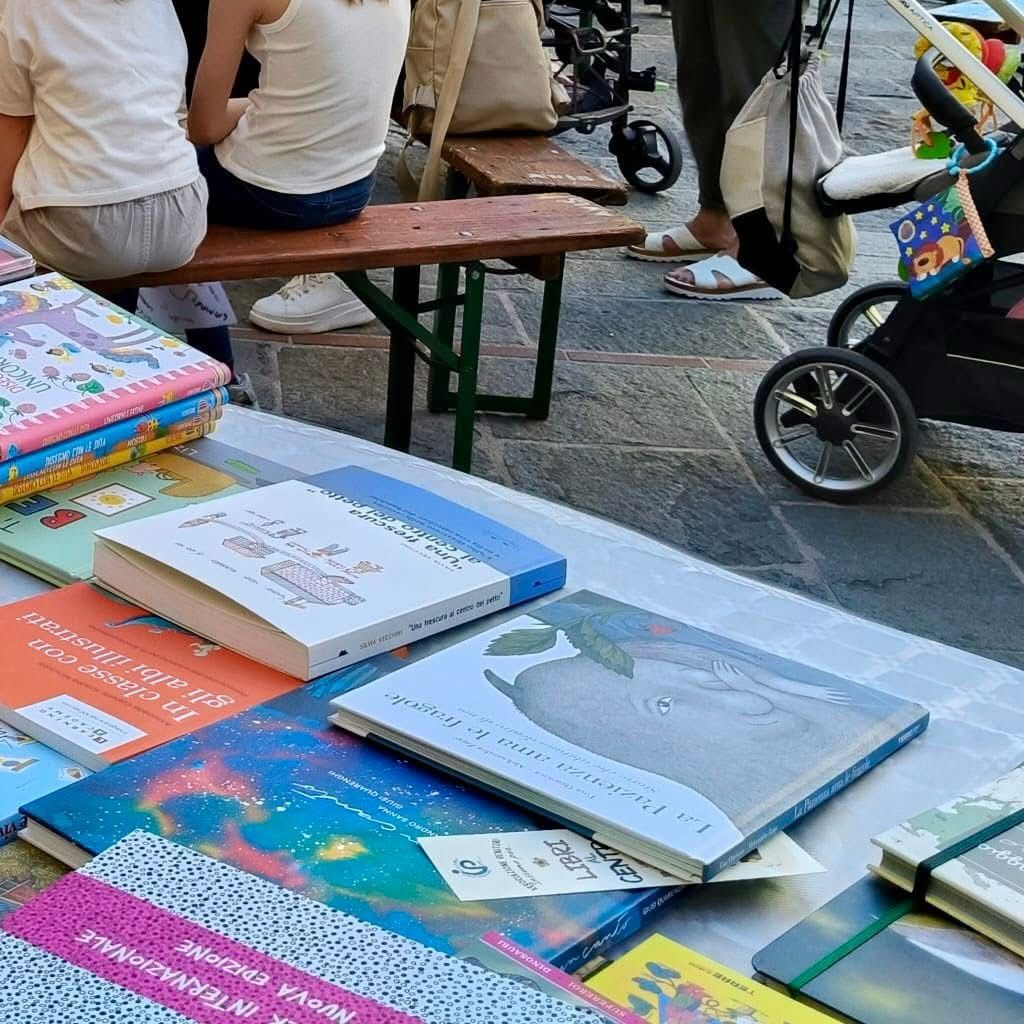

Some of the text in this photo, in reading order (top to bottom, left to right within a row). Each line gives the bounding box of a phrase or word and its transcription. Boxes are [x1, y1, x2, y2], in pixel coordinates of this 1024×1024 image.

[348, 509, 420, 544] frescura
[367, 509, 396, 523] del
[401, 524, 458, 553] centro
[460, 553, 481, 564] al
[423, 612, 448, 630] frescura
[456, 605, 475, 620] centro
[15, 611, 134, 673] illustrati
[27, 637, 79, 665] con
[78, 663, 161, 710] classe
[130, 666, 189, 698] albi
[162, 699, 199, 723] In
[187, 688, 236, 710] gli
[384, 692, 464, 728] fragole
[468, 726, 491, 741] le
[497, 737, 552, 763] ama
[556, 759, 669, 816] Pazienza
[678, 811, 712, 835] La
[544, 840, 598, 880] LIBRI
[495, 936, 553, 975] DINOSAURI
[75, 927, 260, 1018] INTERNAZIONALE
[174, 937, 357, 1024] NUOVA EDIZIONE
